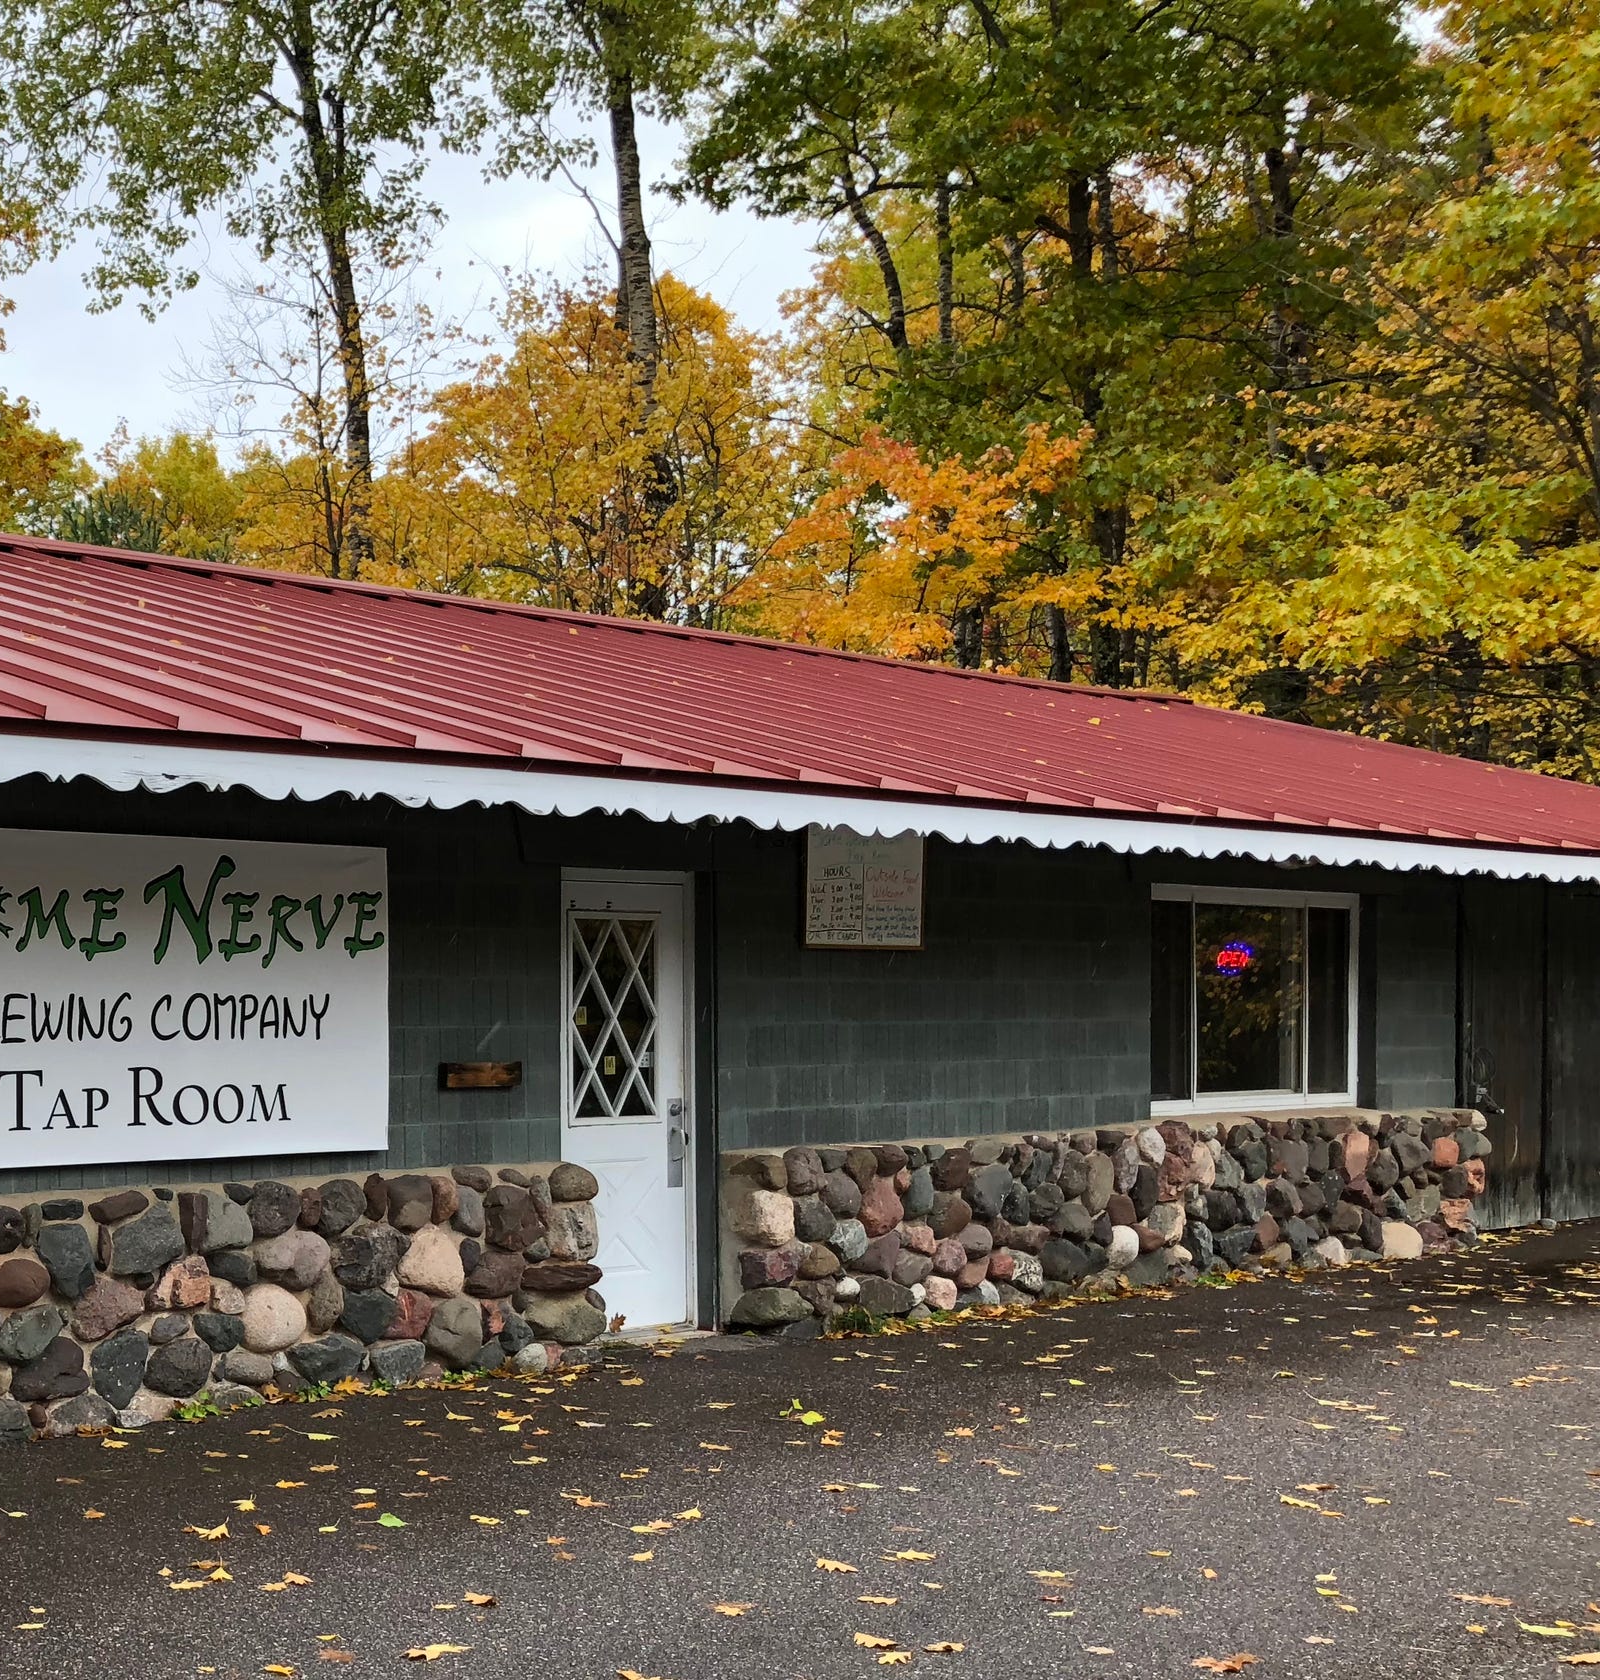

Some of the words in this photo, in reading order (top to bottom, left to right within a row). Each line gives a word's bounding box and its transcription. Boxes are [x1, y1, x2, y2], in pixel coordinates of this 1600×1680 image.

[823, 865, 852, 878] HOURS
[143, 854, 385, 969] NERVE
[1217, 950, 1249, 968] OPEN
[151, 992, 330, 1042] COMPANY
[127, 1066, 292, 1128] ROOM
